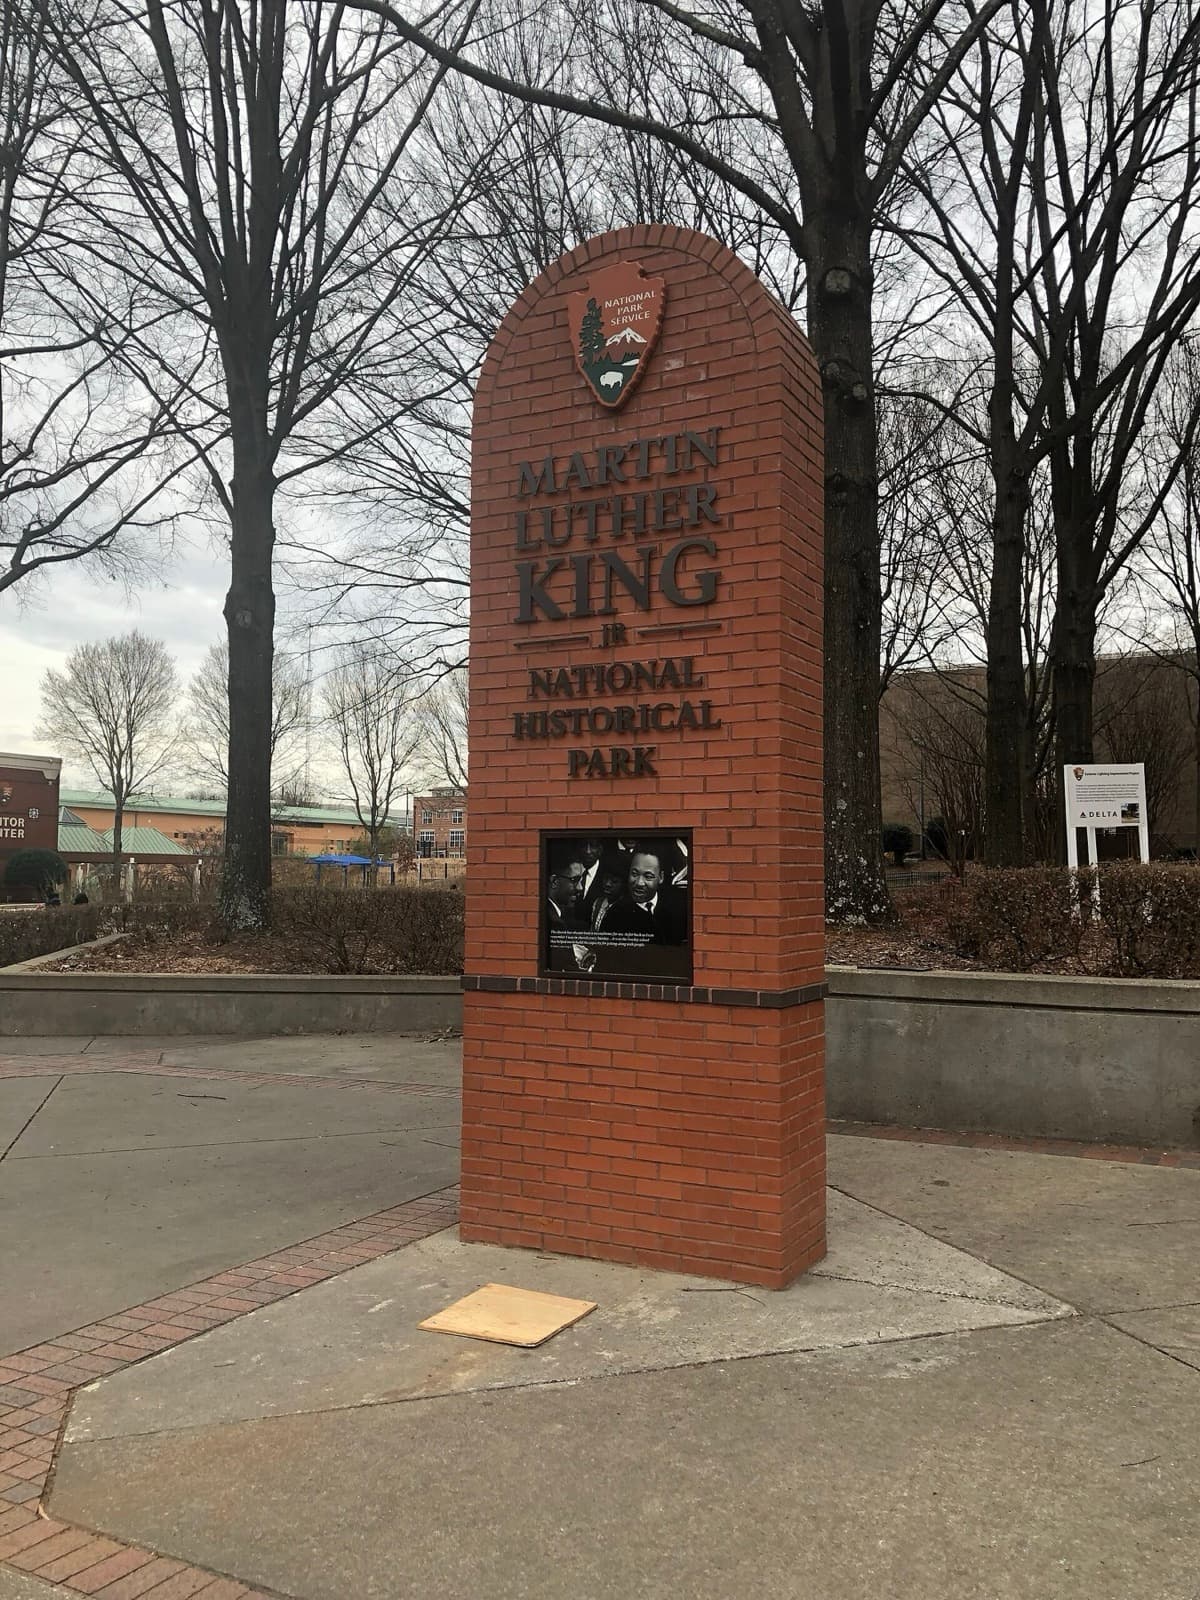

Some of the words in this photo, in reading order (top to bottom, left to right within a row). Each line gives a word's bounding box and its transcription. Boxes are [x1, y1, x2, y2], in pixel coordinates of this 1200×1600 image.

[604, 289, 657, 309] NATIONAL
[617, 303, 644, 316] PARK
[610, 310, 651, 326] SERVICE
[517, 426, 722, 499] MARTIN
[515, 484, 721, 549] LUTHER
[514, 538, 722, 624] KING
[599, 622, 626, 649] JR
[528, 656, 704, 698] NATIONAL
[511, 700, 722, 739] HISTORICAL
[567, 746, 658, 778] PARK
